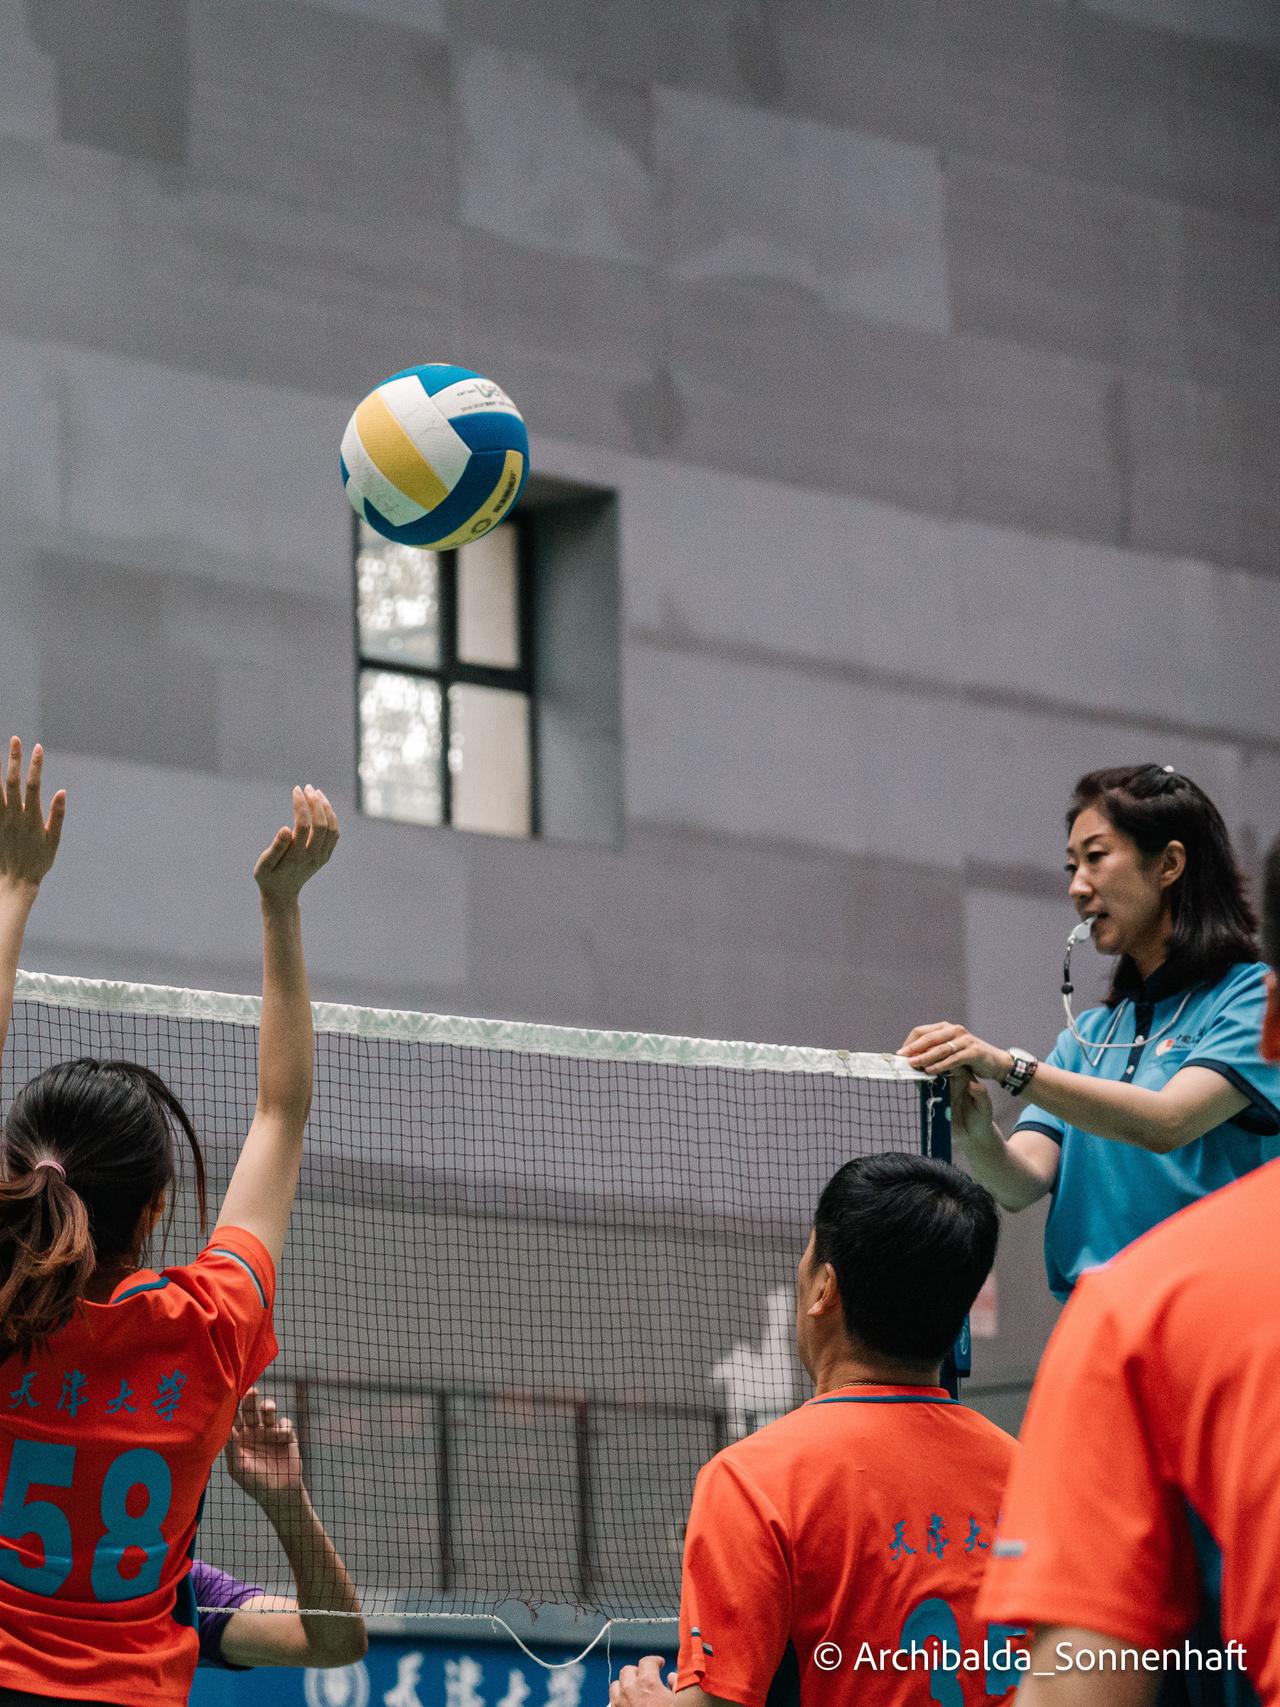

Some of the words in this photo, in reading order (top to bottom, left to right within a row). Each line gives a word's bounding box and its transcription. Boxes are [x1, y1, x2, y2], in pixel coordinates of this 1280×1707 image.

[8, 1368, 188, 1422] 天津大学
[889, 1511, 1004, 1560] 天津大
